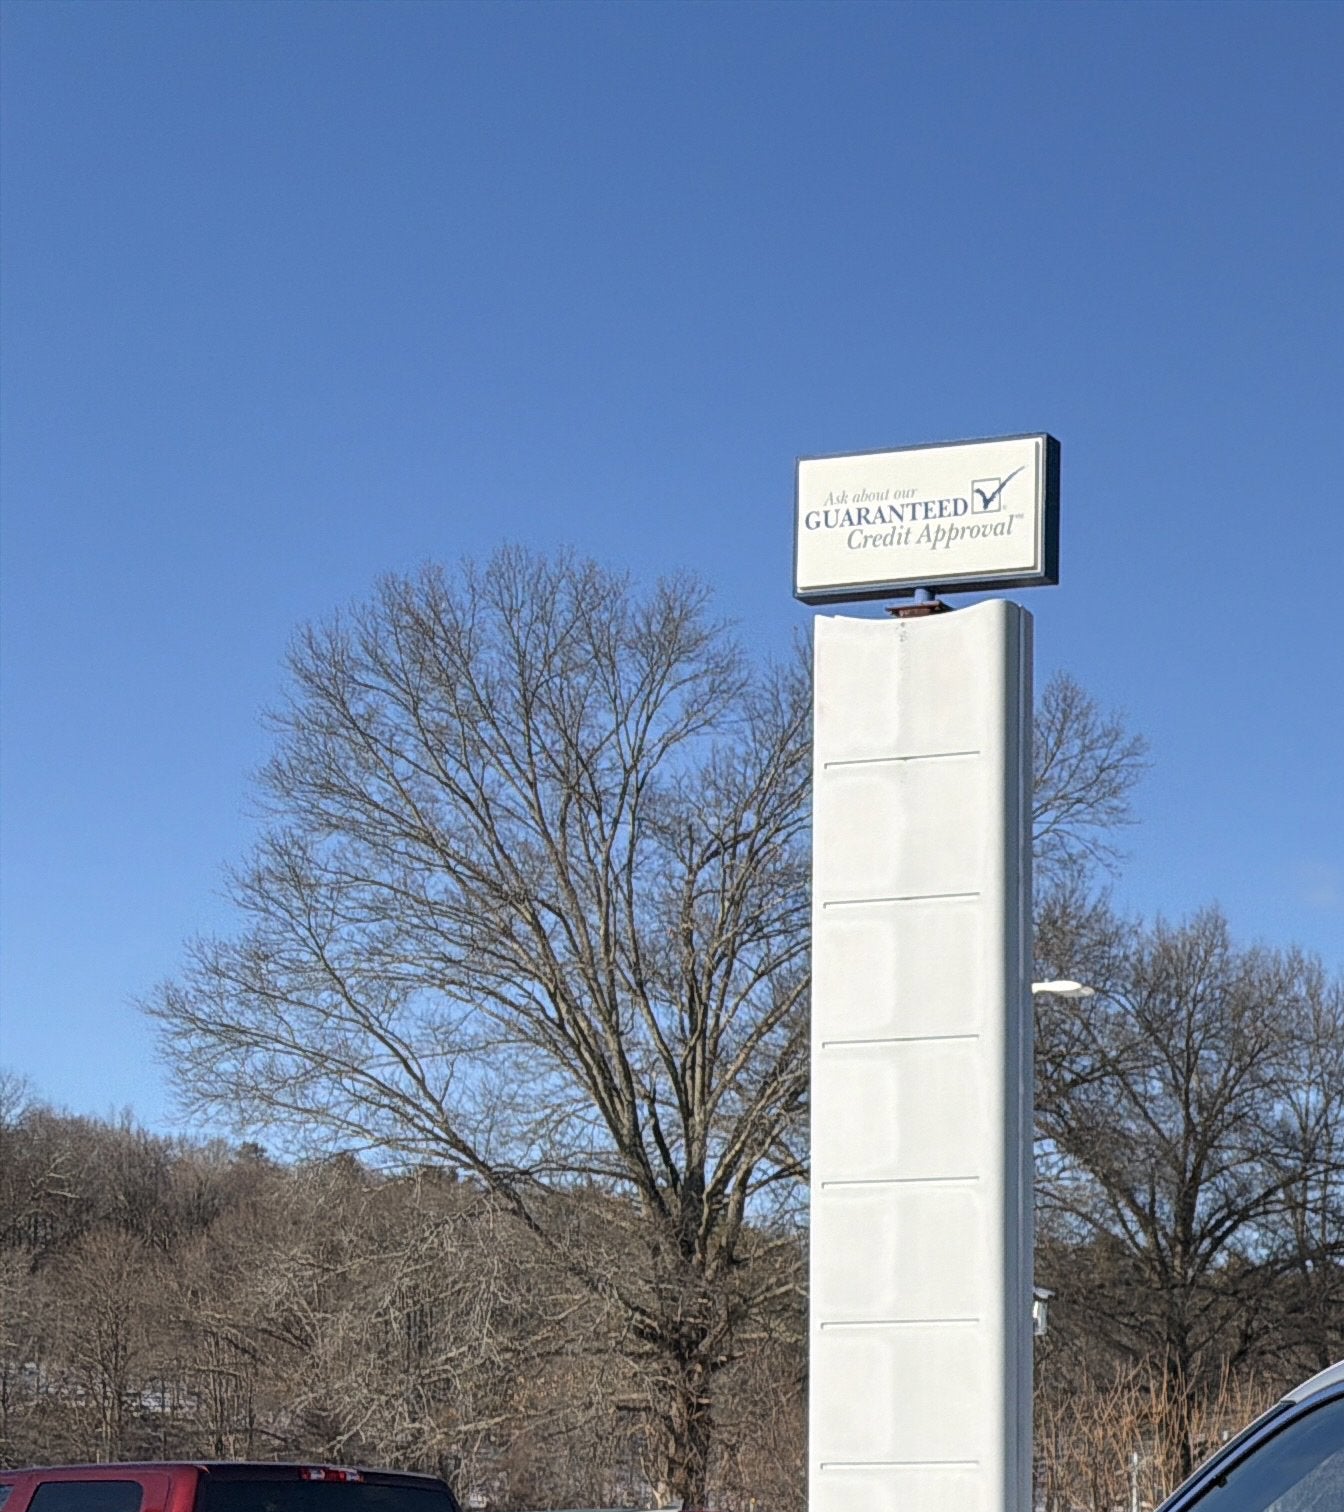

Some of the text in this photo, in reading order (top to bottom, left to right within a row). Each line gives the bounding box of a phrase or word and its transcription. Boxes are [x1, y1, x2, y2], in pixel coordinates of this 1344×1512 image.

[804, 497, 969, 531] GUARANTEED
[823, 488, 918, 507] Ask about our
[847, 514, 1013, 550] Credit Approval
